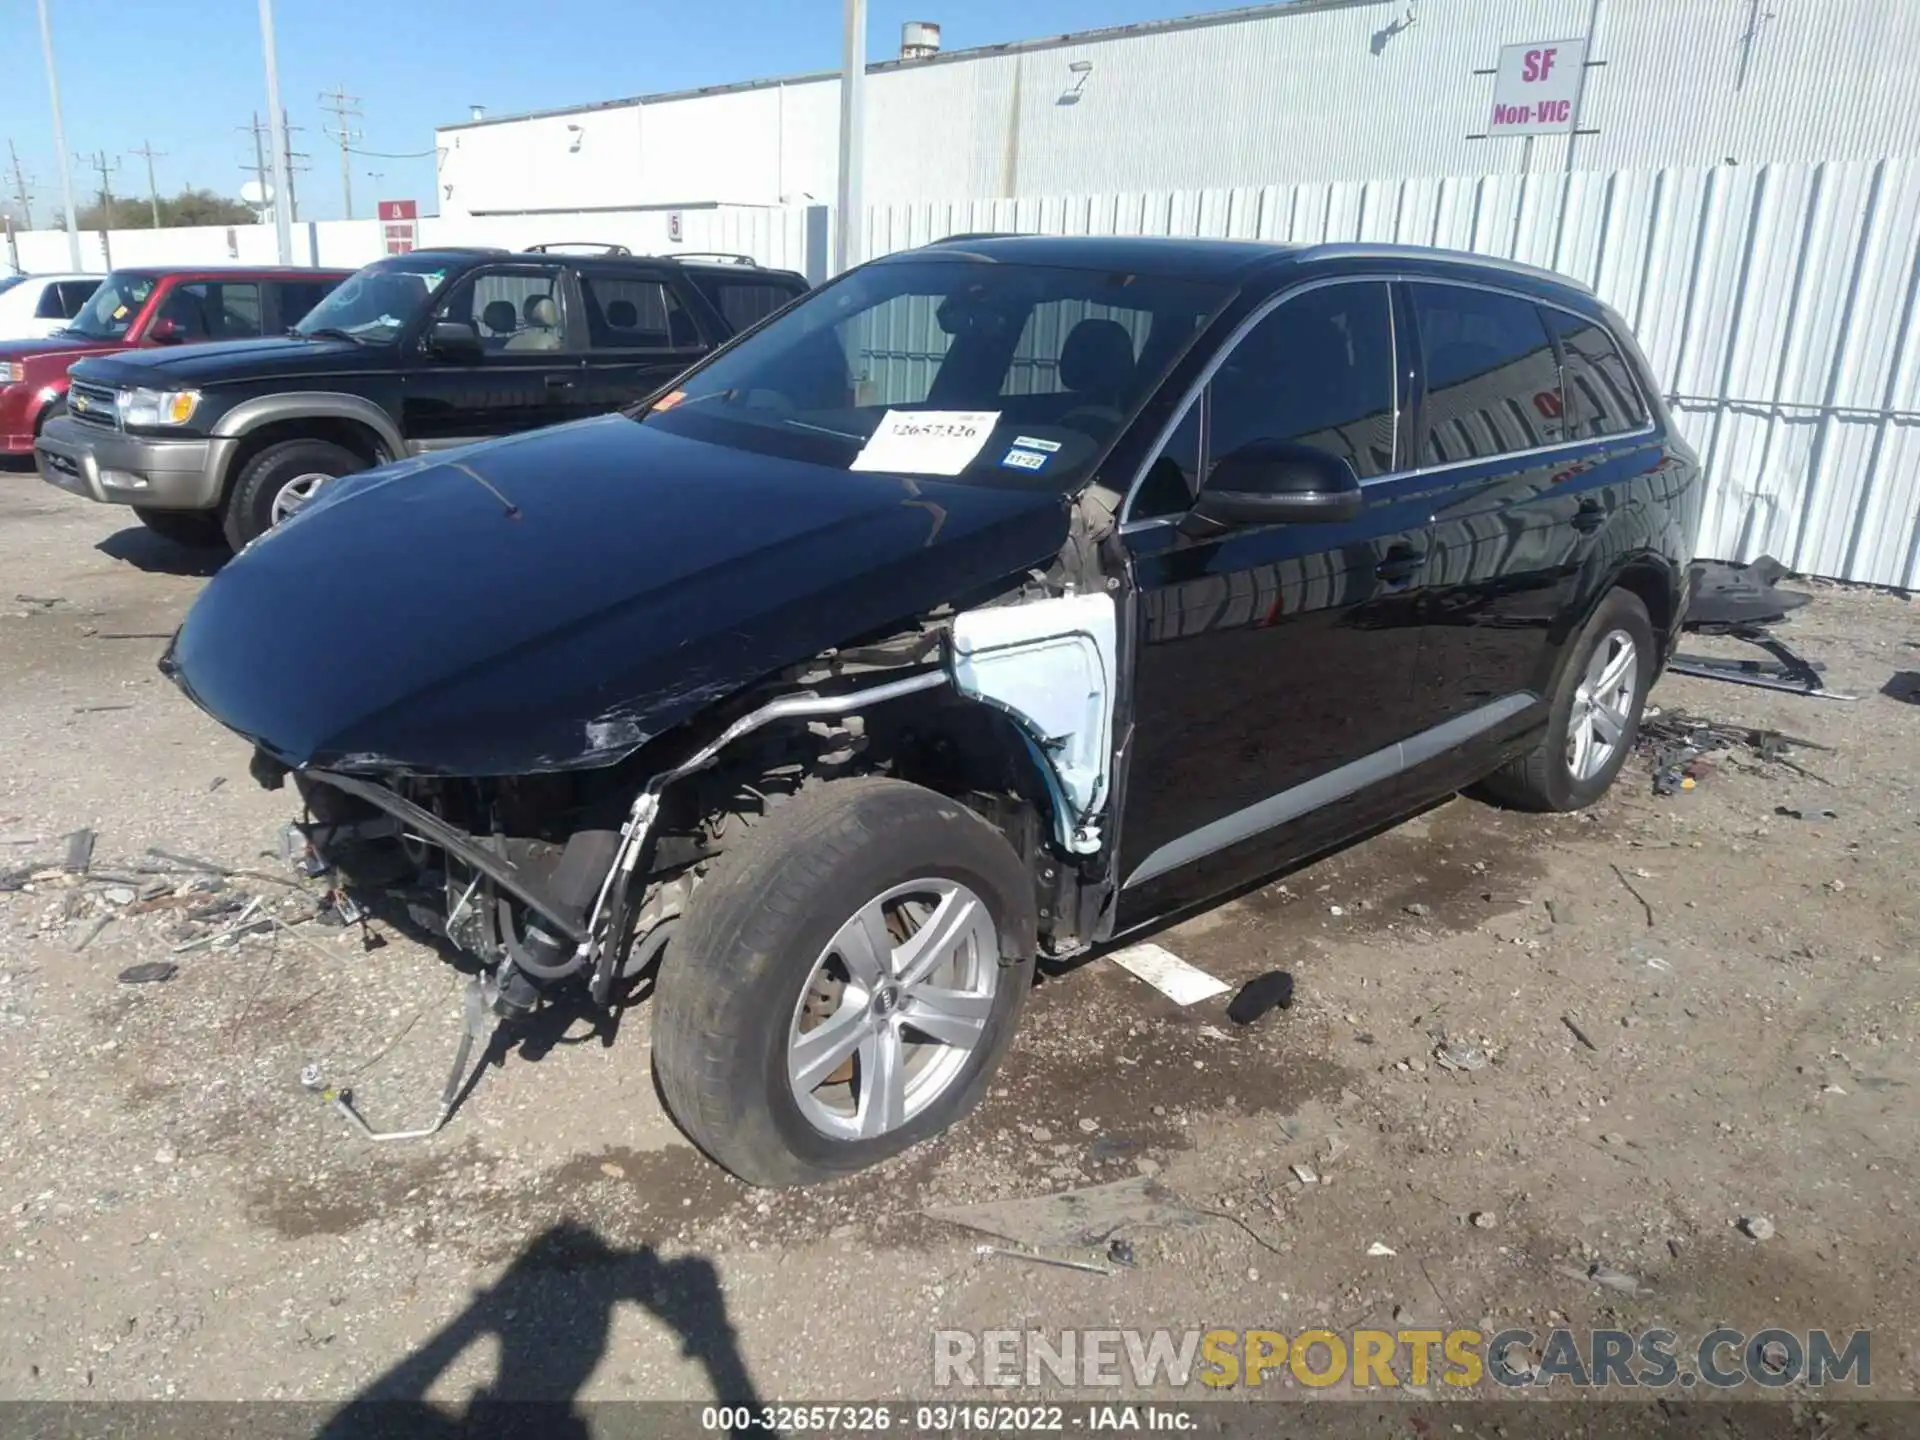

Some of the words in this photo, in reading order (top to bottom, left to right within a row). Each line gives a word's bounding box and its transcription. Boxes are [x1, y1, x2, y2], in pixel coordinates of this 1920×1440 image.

[1522, 48, 1558, 83] SF
[1493, 99, 1571, 125] Non-VIC
[672, 215, 679, 235] 5
